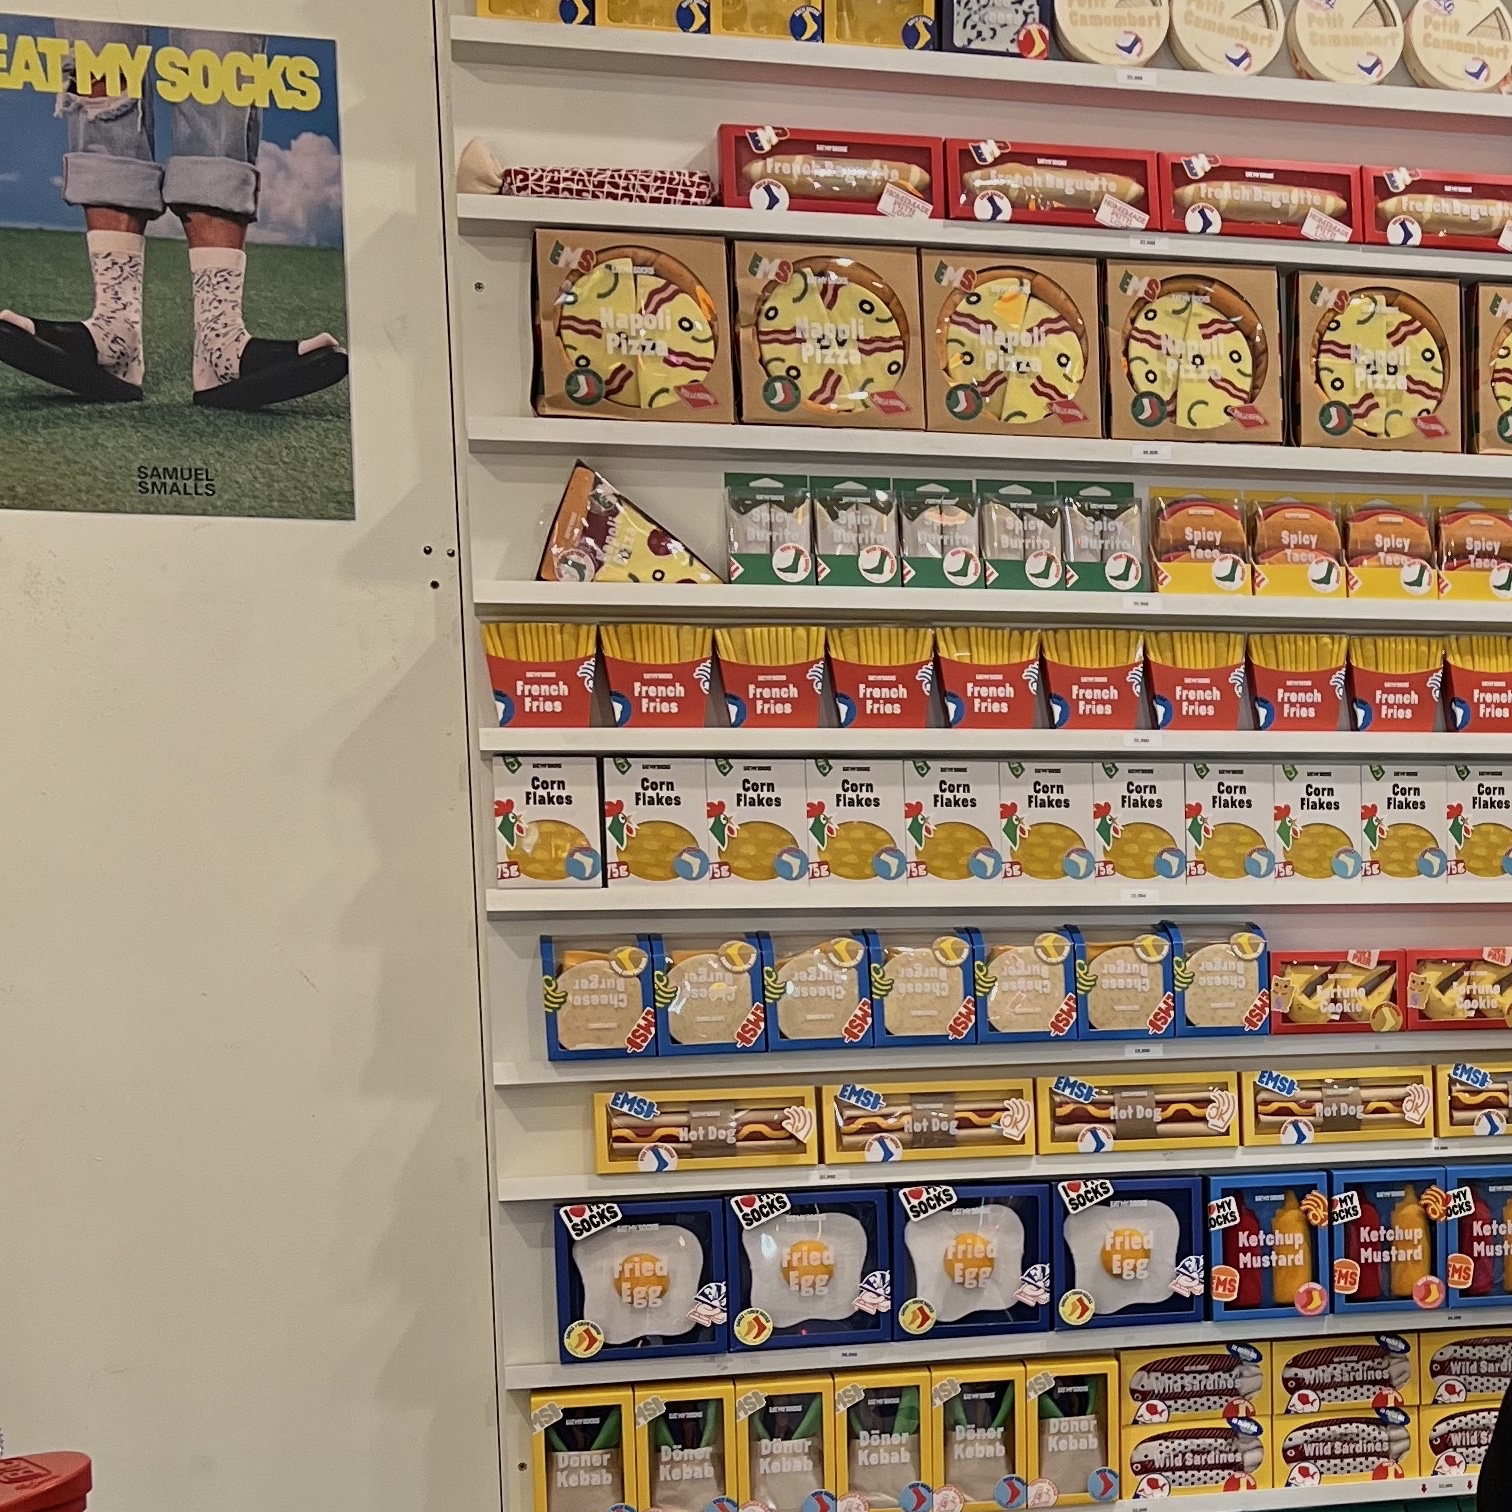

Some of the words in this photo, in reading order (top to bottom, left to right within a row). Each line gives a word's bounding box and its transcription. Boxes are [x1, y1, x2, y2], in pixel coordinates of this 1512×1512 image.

[74, 40, 152, 99] MY
[155, 46, 321, 111] SOCKS
[600, 307, 672, 331] Napoli
[607, 334, 669, 356] Pizza
[979, 327, 1046, 350] Napoli
[985, 353, 1042, 372] Pizza
[137, 465, 214, 482] SAMUEL
[137, 480, 216, 497] SMALLS
[1184, 527, 1222, 545] Spicy
[1281, 530, 1318, 549] Spicy
[516, 681, 569, 698] French
[633, 681, 685, 699] French
[748, 683, 798, 700] French
[966, 683, 1014, 699] French
[1175, 686, 1221, 702] French
[1375, 690, 1419, 706] French
[524, 698, 563, 714] Fries
[641, 698, 679, 715] Fries
[756, 700, 793, 716] Fries
[973, 699, 1009, 715] Fries
[1182, 701, 1215, 717] Fries
[1381, 704, 1413, 720] Fries
[1479, 703, 1510, 719] Fries
[530, 776, 566, 792] Corn
[640, 777, 675, 792] Corn
[741, 778, 775, 793] Corn
[841, 779, 874, 794] Corn
[1217, 781, 1247, 796] Corn
[1391, 783, 1421, 797] Corn
[525, 791, 573, 807] Flakes
[634, 791, 682, 807] Flakes
[736, 792, 782, 808] Flakes
[835, 793, 880, 808] Flakes
[1211, 795, 1253, 810] Flakes
[1386, 796, 1426, 811] Flakes
[1109, 1104, 1134, 1120] Hot
[1135, 1105, 1162, 1123] Dog
[679, 1127, 704, 1142] Hot
[707, 1126, 737, 1144] Dog
[904, 1118, 927, 1133] Hot
[928, 1117, 959, 1137] Dog
[1217, 1199, 1231, 1212] MY
[571, 1206, 618, 1237] SOCKS
[1238, 1230, 1304, 1249] Ketchup
[1360, 1226, 1423, 1246] Ketchup
[782, 1245, 835, 1267] Fried
[945, 1238, 995, 1259] Fried
[1360, 1244, 1422, 1264] Mustard
[613, 1255, 668, 1278] Fried
[1239, 1250, 1304, 1268] Mustard
[953, 1262, 992, 1287] Egg
[789, 1271, 829, 1297] Egg
[621, 1282, 663, 1309] Egg
[859, 1428, 909, 1447] Döner
[1304, 1441, 1331, 1456] Wild
[1334, 1439, 1389, 1455] Sardines
[858, 1447, 910, 1466] Kebab
[1154, 1451, 1184, 1467] Wild
[1185, 1449, 1241, 1465] Sardines
[556, 1468, 613, 1488] Kebab
